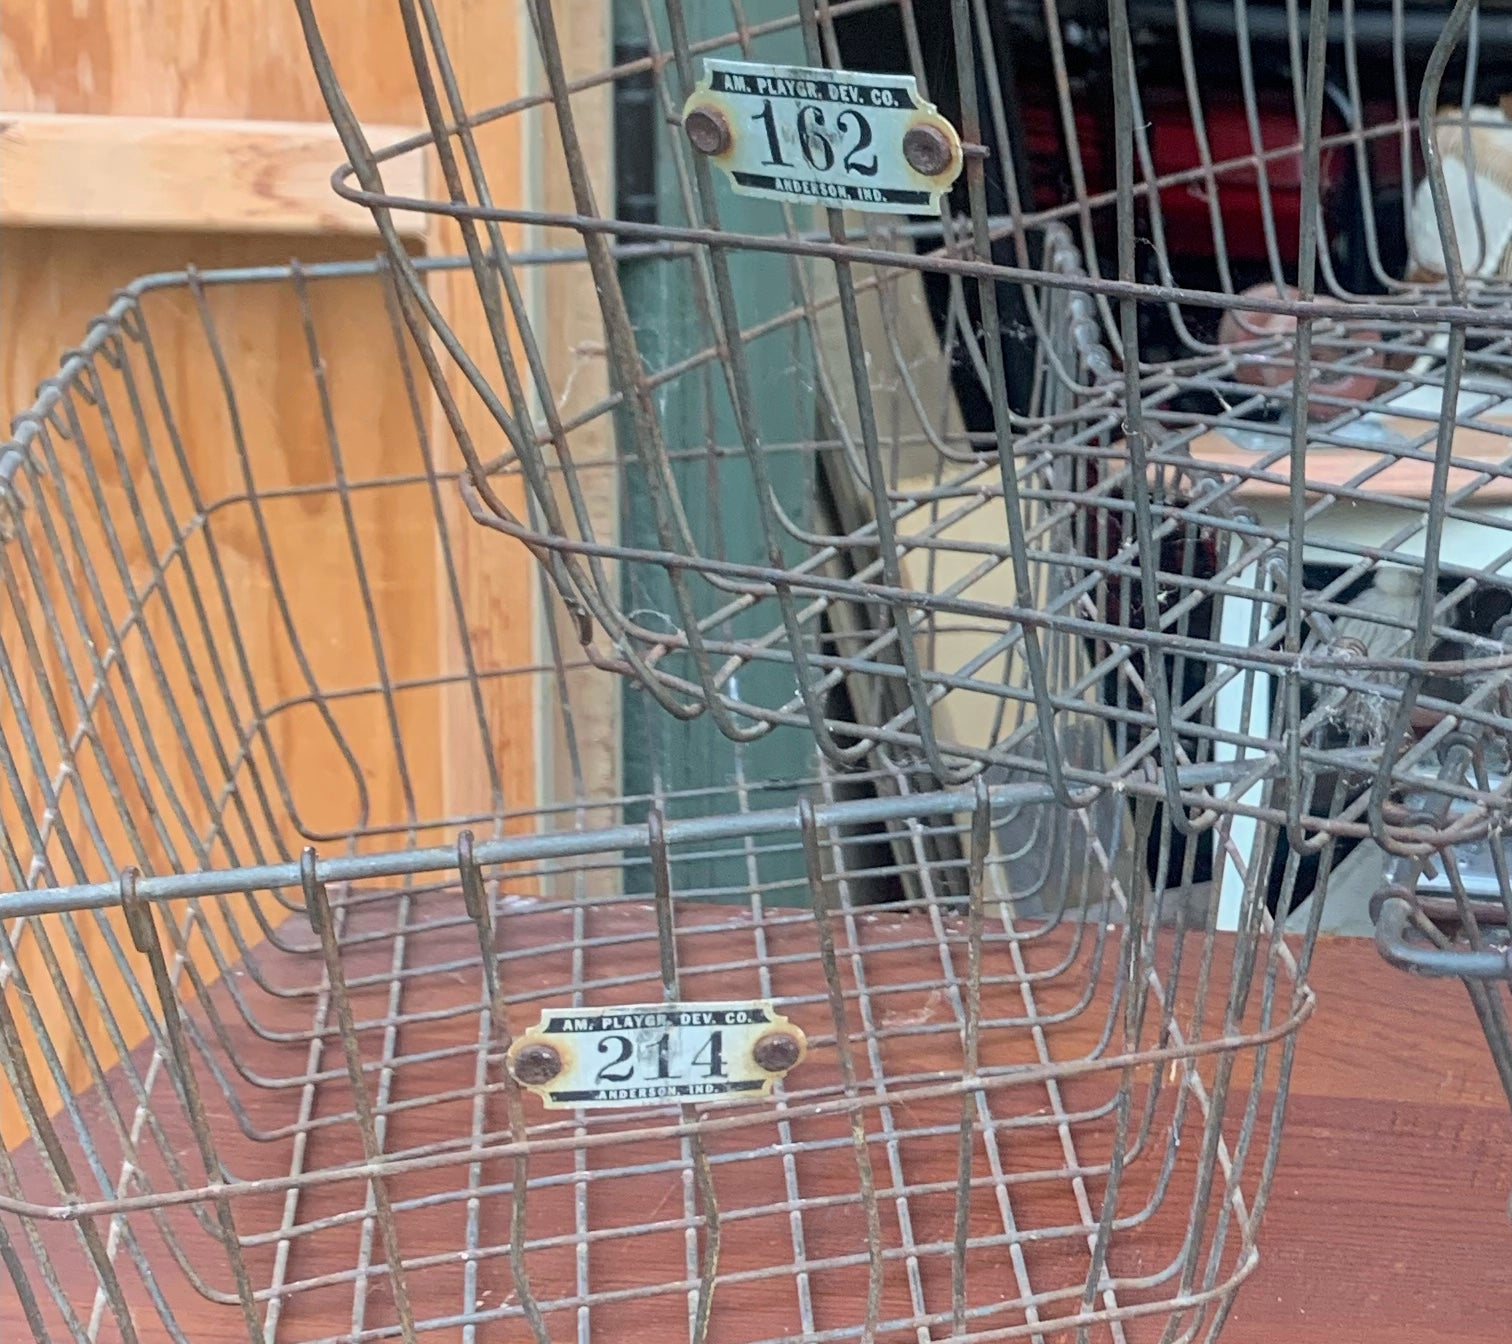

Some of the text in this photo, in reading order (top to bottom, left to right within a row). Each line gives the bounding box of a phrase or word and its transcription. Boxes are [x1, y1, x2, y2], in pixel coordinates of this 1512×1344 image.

[724, 76, 899, 107] AM. PLAYGR. DEV. CO.
[751, 99, 878, 177] 162
[774, 178, 888, 203] ANDERSON, IND.
[562, 1018, 594, 1031] AM.
[680, 1012, 717, 1026] DEV.
[725, 1011, 753, 1024] CO.
[597, 1030, 728, 1082] 214
[688, 1082, 719, 1095] IND.
